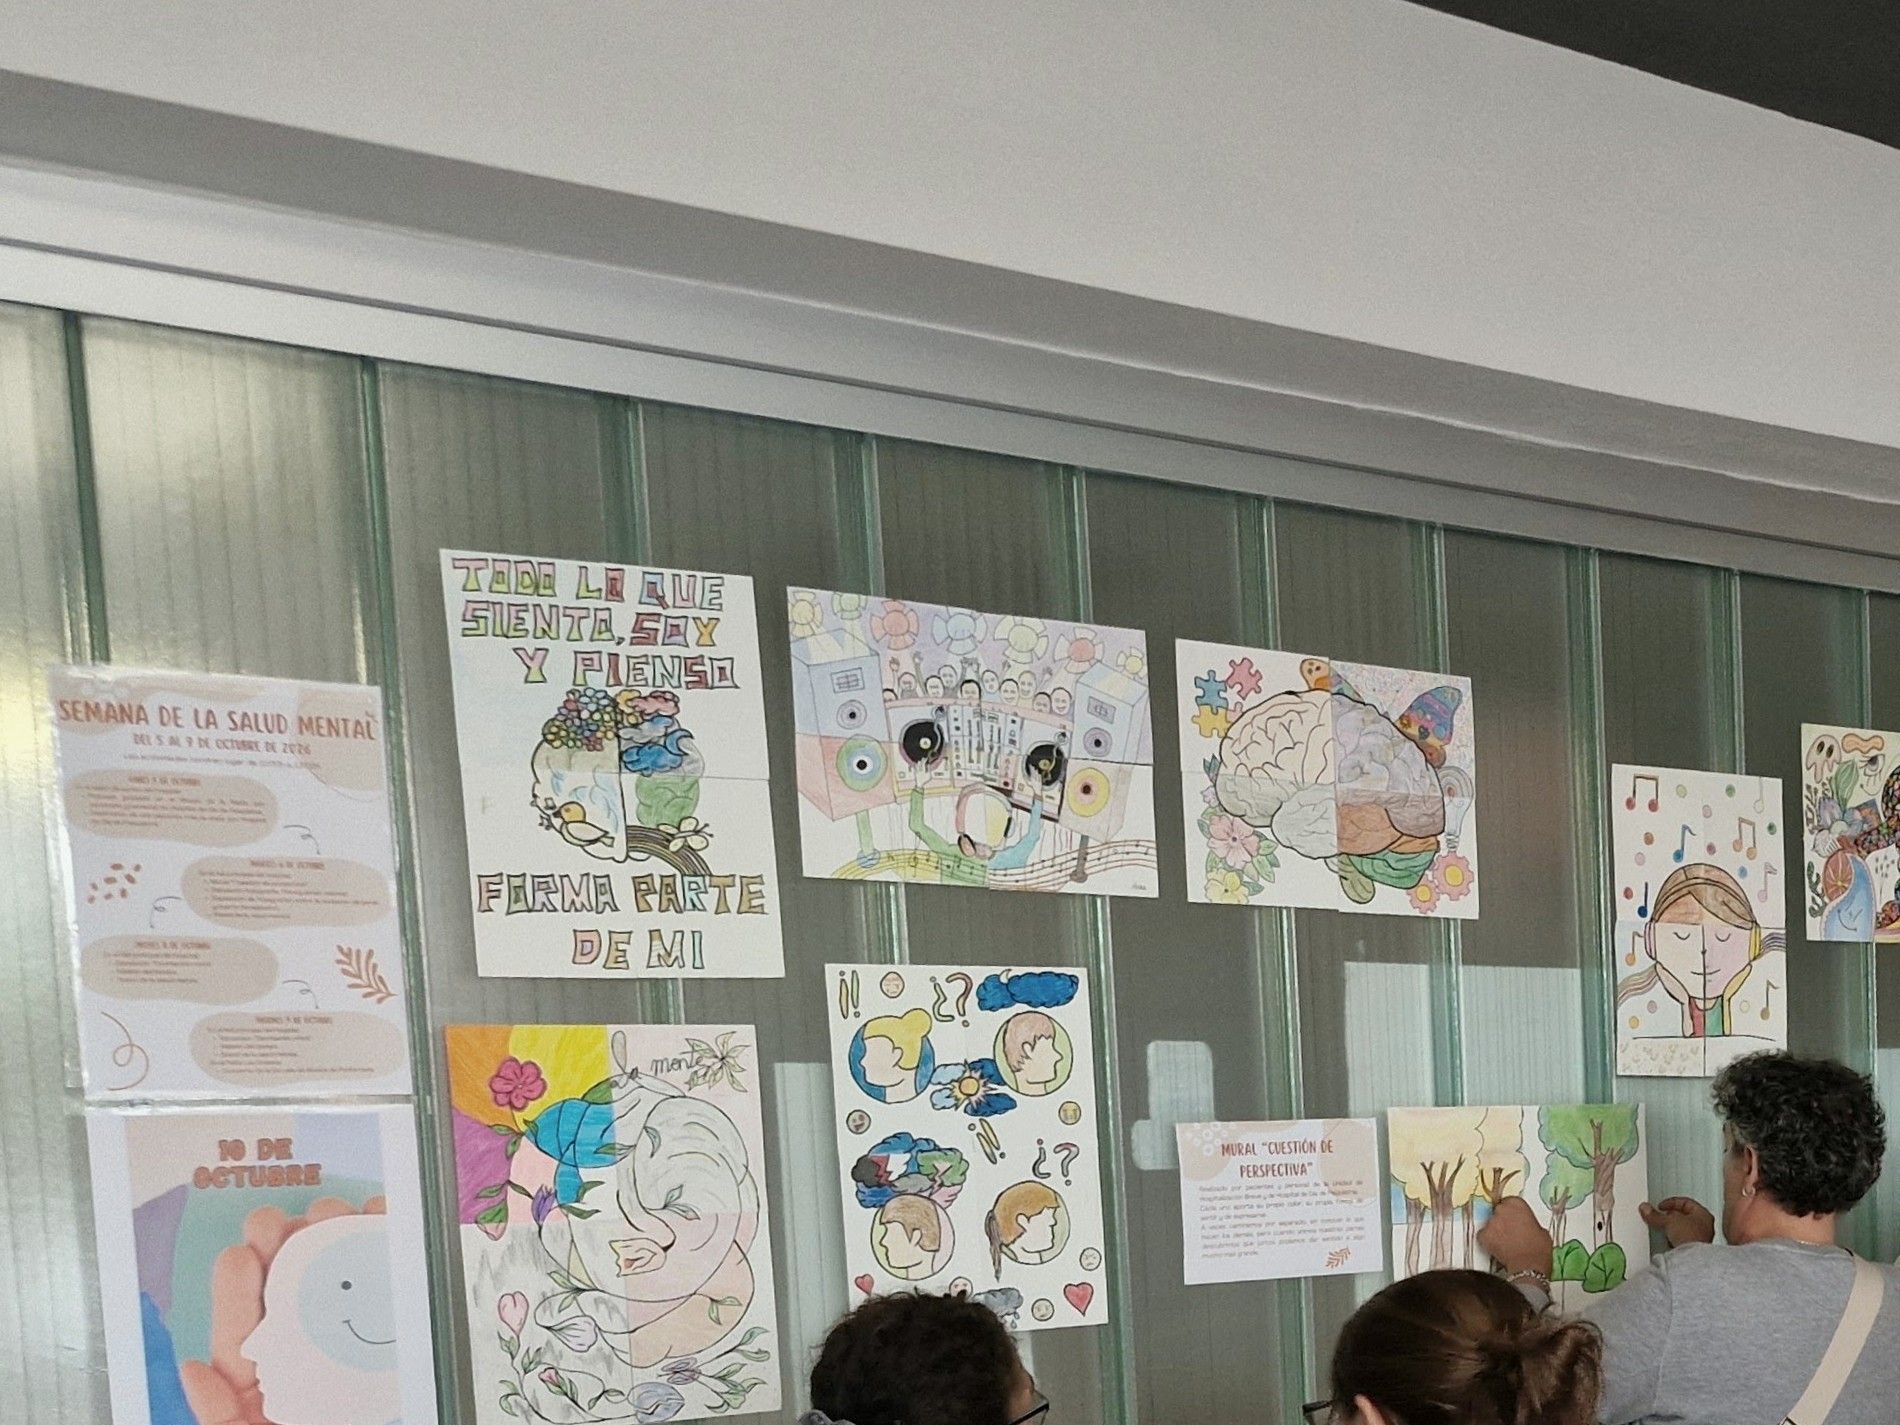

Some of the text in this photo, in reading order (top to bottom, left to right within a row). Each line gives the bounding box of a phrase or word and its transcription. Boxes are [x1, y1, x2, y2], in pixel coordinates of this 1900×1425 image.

[452, 558, 725, 610] TODO LO QUE
[461, 601, 720, 648] SIENTO, SOY
[513, 647, 740, 690] Y PIENSO
[58, 699, 377, 740] SEMANA DE LA SALUD MENTAL
[133, 734, 152, 746] DEL
[156, 735, 164, 745] 5
[168, 735, 181, 747] AL
[186, 737, 193, 747] 9
[198, 737, 211, 749] DE
[215, 738, 261, 753] OCTUBRE
[265, 741, 277, 753] DE
[477, 872, 768, 916] FORMA PARTE
[572, 930, 705, 970] DE MI
[218, 1138, 294, 1161] 10 DE
[1221, 1142, 1257, 1156] MURAL
[1321, 1140, 1334, 1154] DE
[193, 1163, 322, 1189] OCTUBRE
[1240, 1162, 1313, 1178] PERSPECTIVA"
